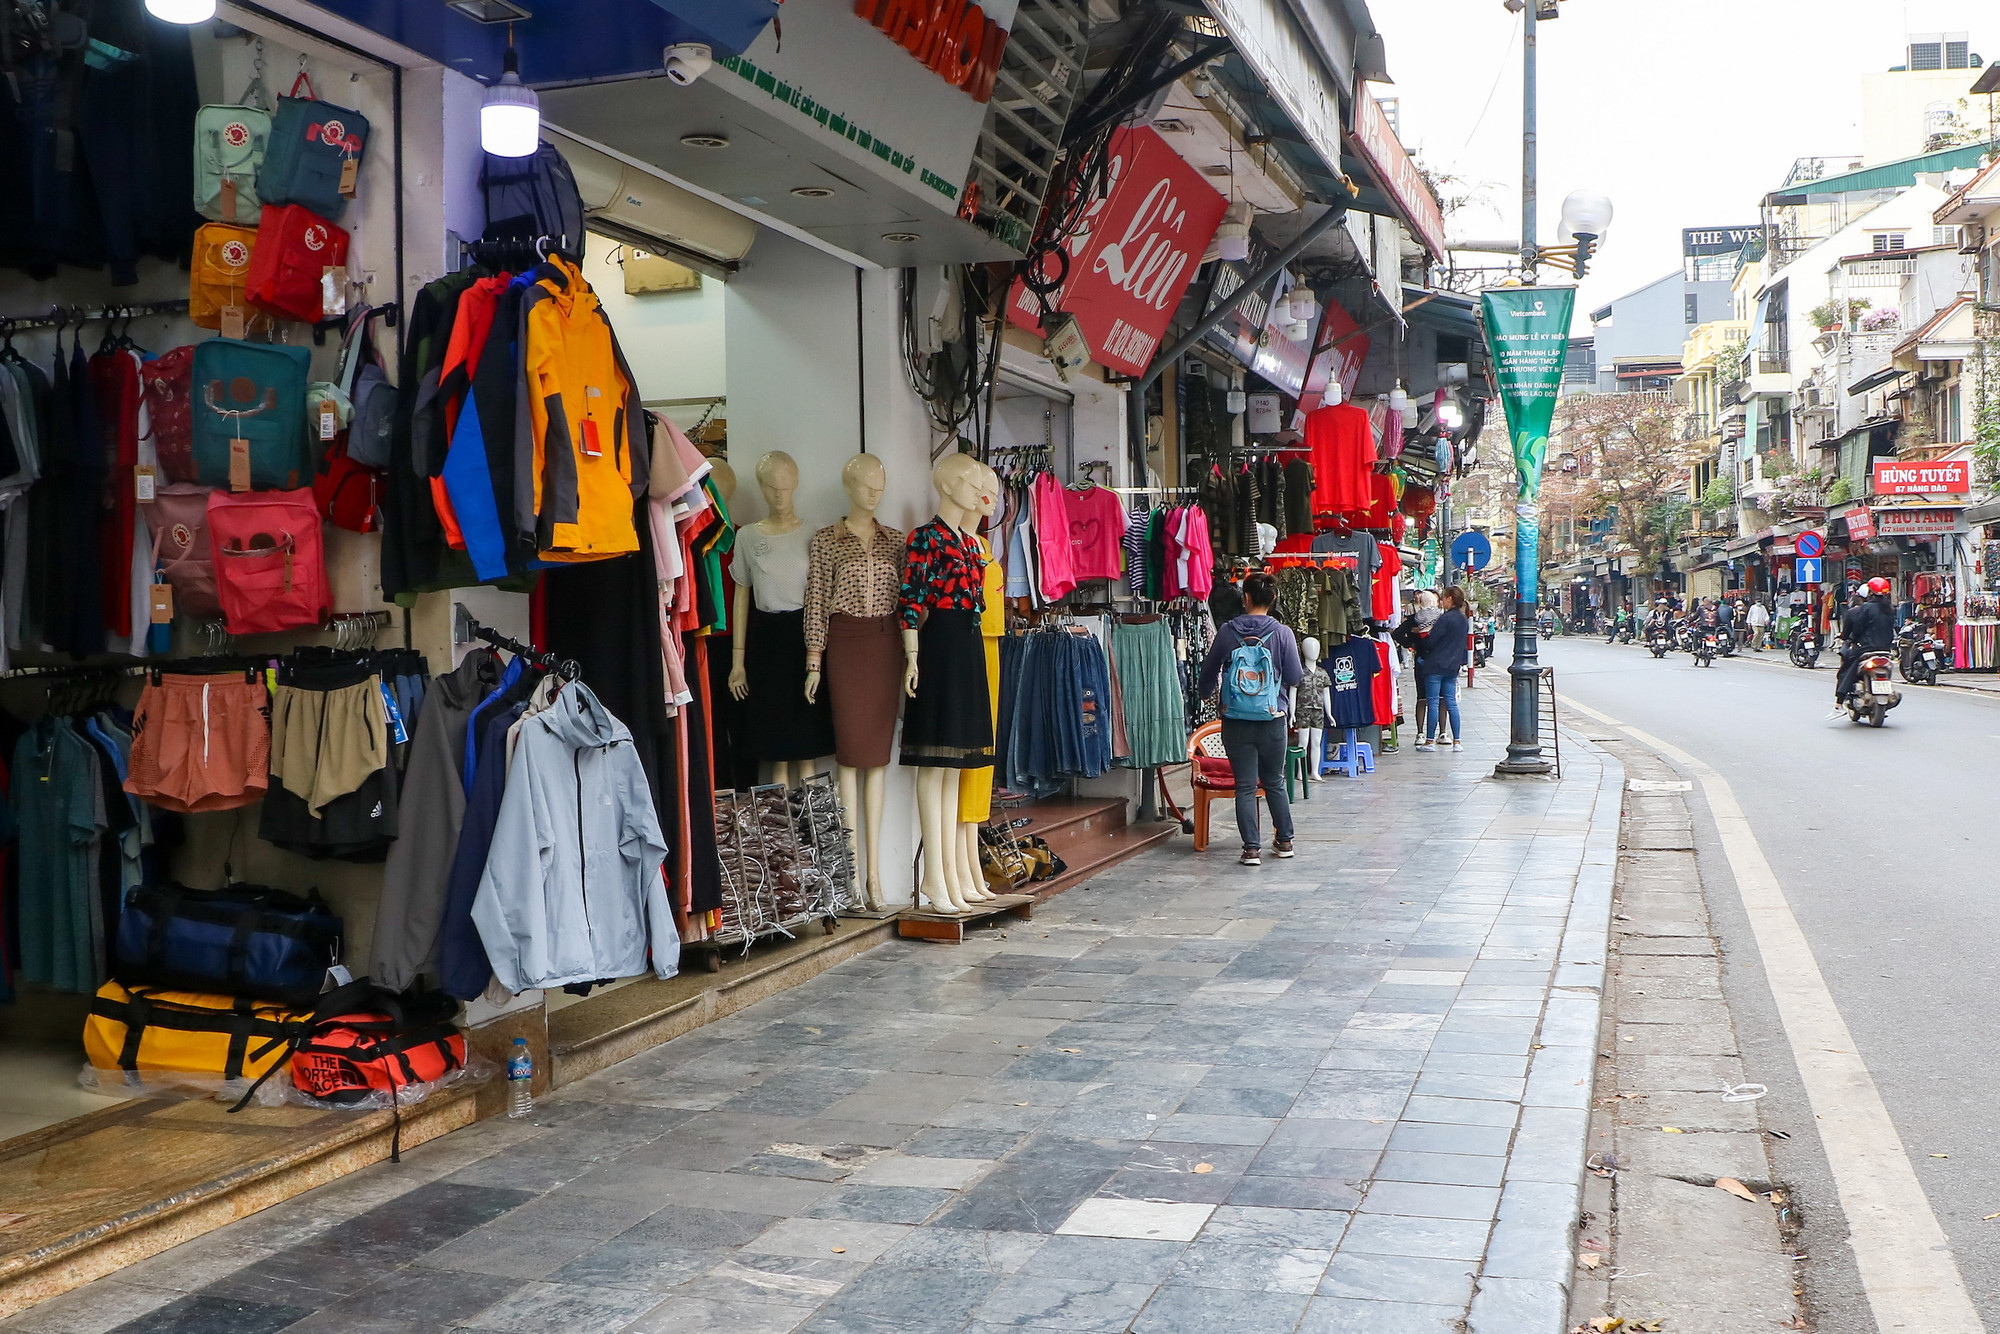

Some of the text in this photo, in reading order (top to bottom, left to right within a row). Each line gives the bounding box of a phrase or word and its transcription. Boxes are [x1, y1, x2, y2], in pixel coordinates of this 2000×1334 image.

[1688, 229, 1763, 245] THE WES
[1509, 332, 1529, 341] MỪNG
[1530, 332, 1540, 341] LỄ
[1540, 332, 1550, 340] KỶ
[1547, 349, 1560, 357] LẬP
[1519, 357, 1538, 365] HÀNG
[1880, 462, 1962, 483] HÙNG TUYẾT
[1895, 484, 1948, 493] 67 HÀNG ĐÀO
[311, 1055, 336, 1069] THE
[302, 1067, 337, 1081] ORTH
